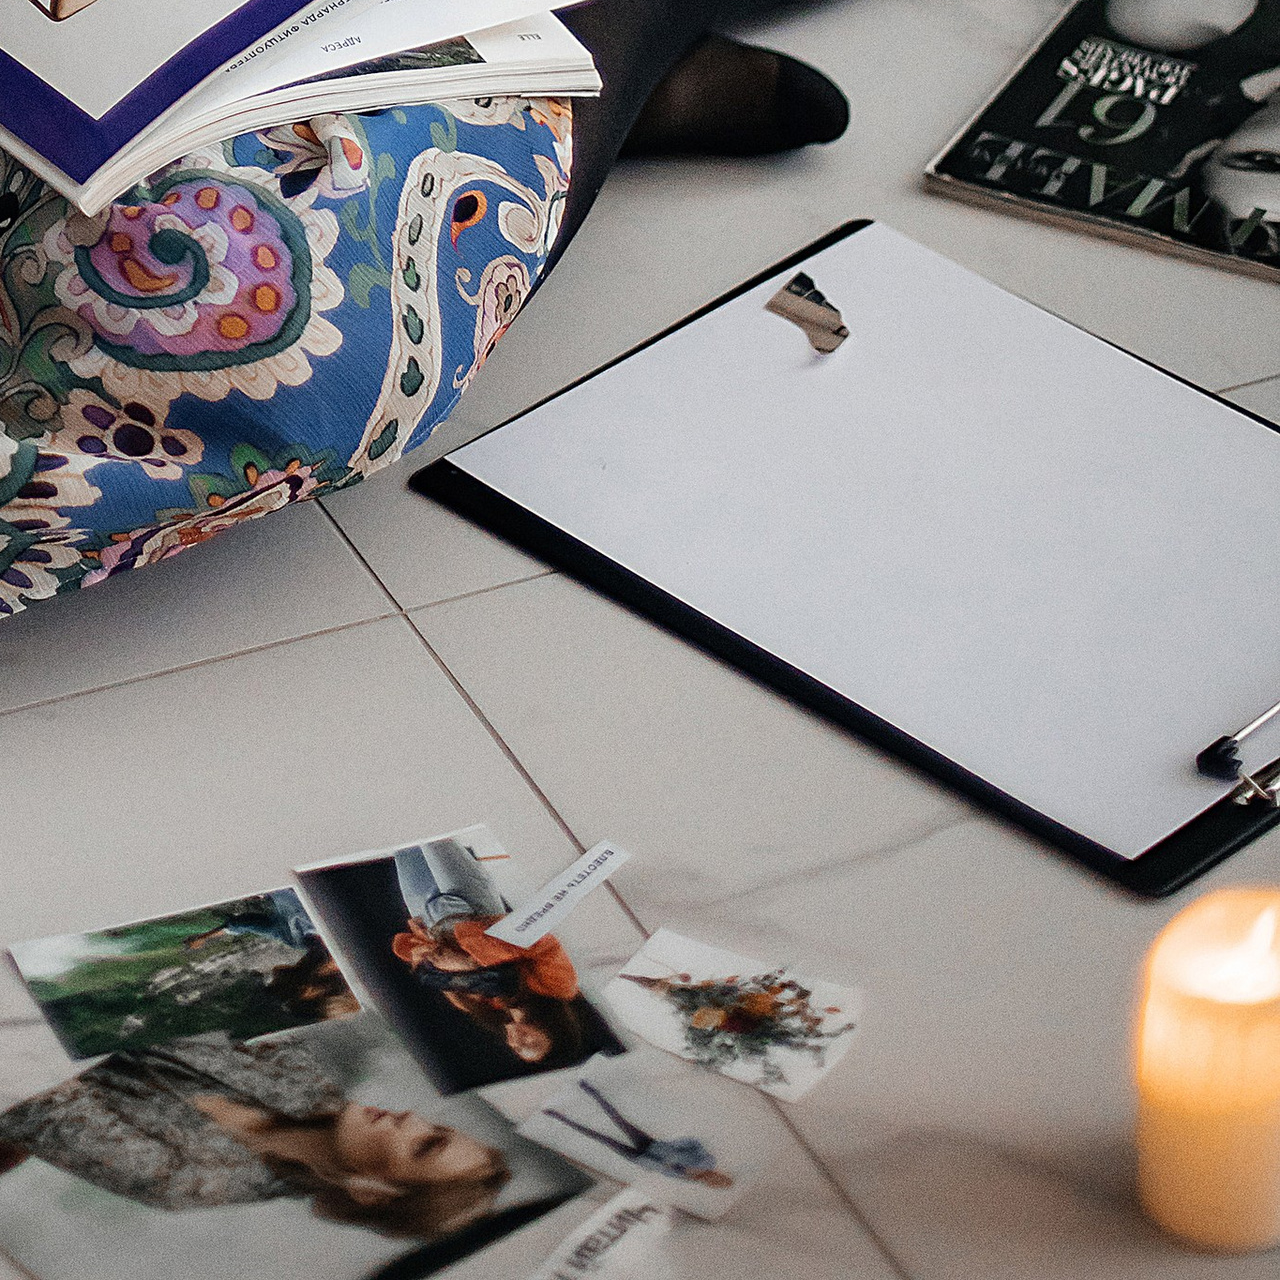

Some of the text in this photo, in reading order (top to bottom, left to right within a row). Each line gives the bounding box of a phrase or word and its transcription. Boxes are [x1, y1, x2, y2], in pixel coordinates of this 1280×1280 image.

[320, 35, 363, 53] АДРЕСА
[518, 33, 542, 42] ELLE
[1034, 77, 1157, 146] 61
